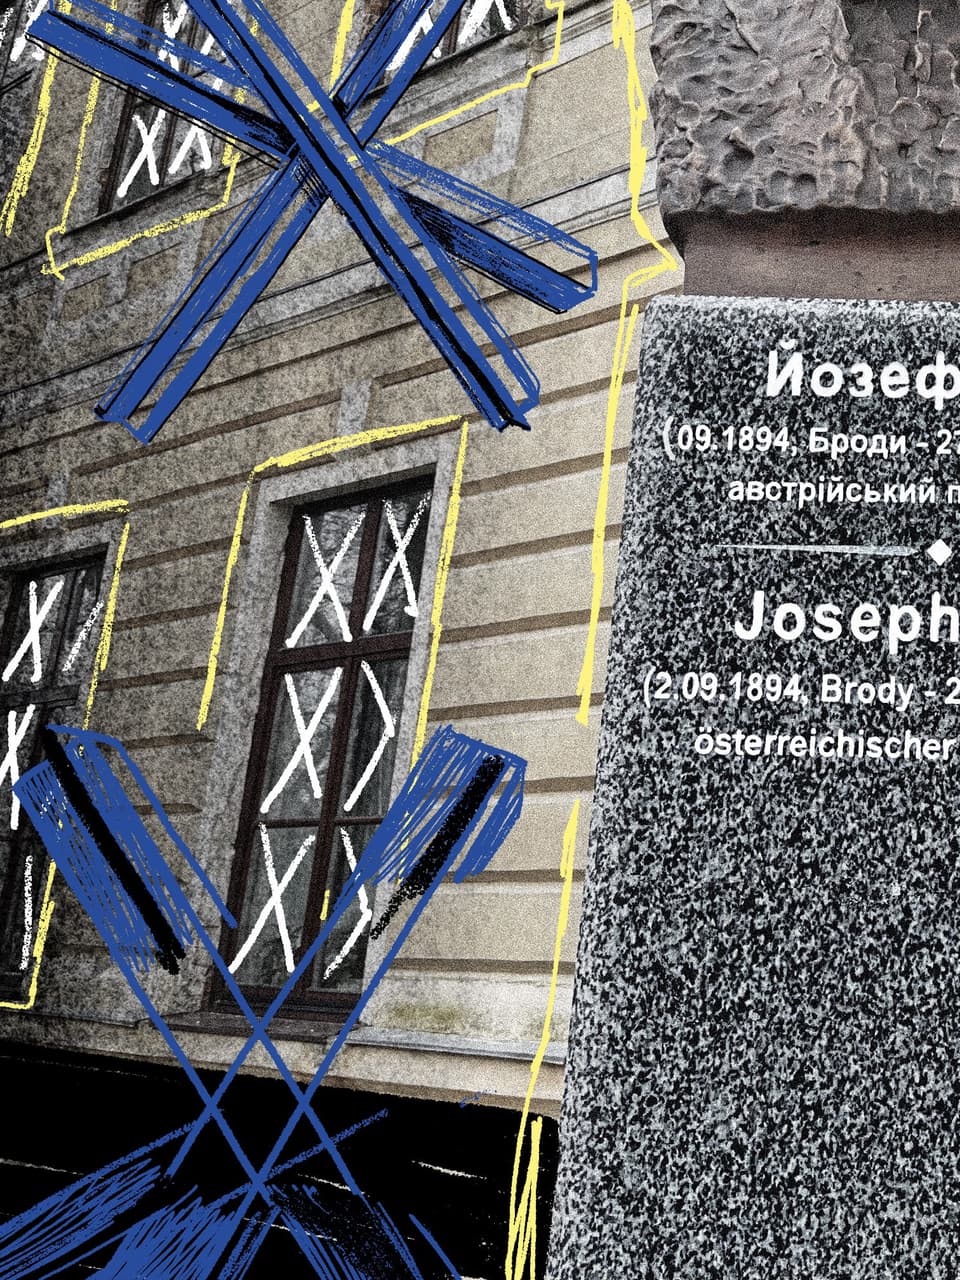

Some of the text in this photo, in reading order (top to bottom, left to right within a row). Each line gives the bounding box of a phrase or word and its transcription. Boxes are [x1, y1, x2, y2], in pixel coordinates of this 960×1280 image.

[662, 416, 798, 460] (09.1894,
[809, 427, 906, 459] Броди
[727, 475, 936, 508] австрійський
[733, 589, 960, 654] Joseph
[643, 667, 809, 708] (2.09.1894,
[821, 673, 914, 711] Brody
[694, 726, 955, 762] österreichischer
